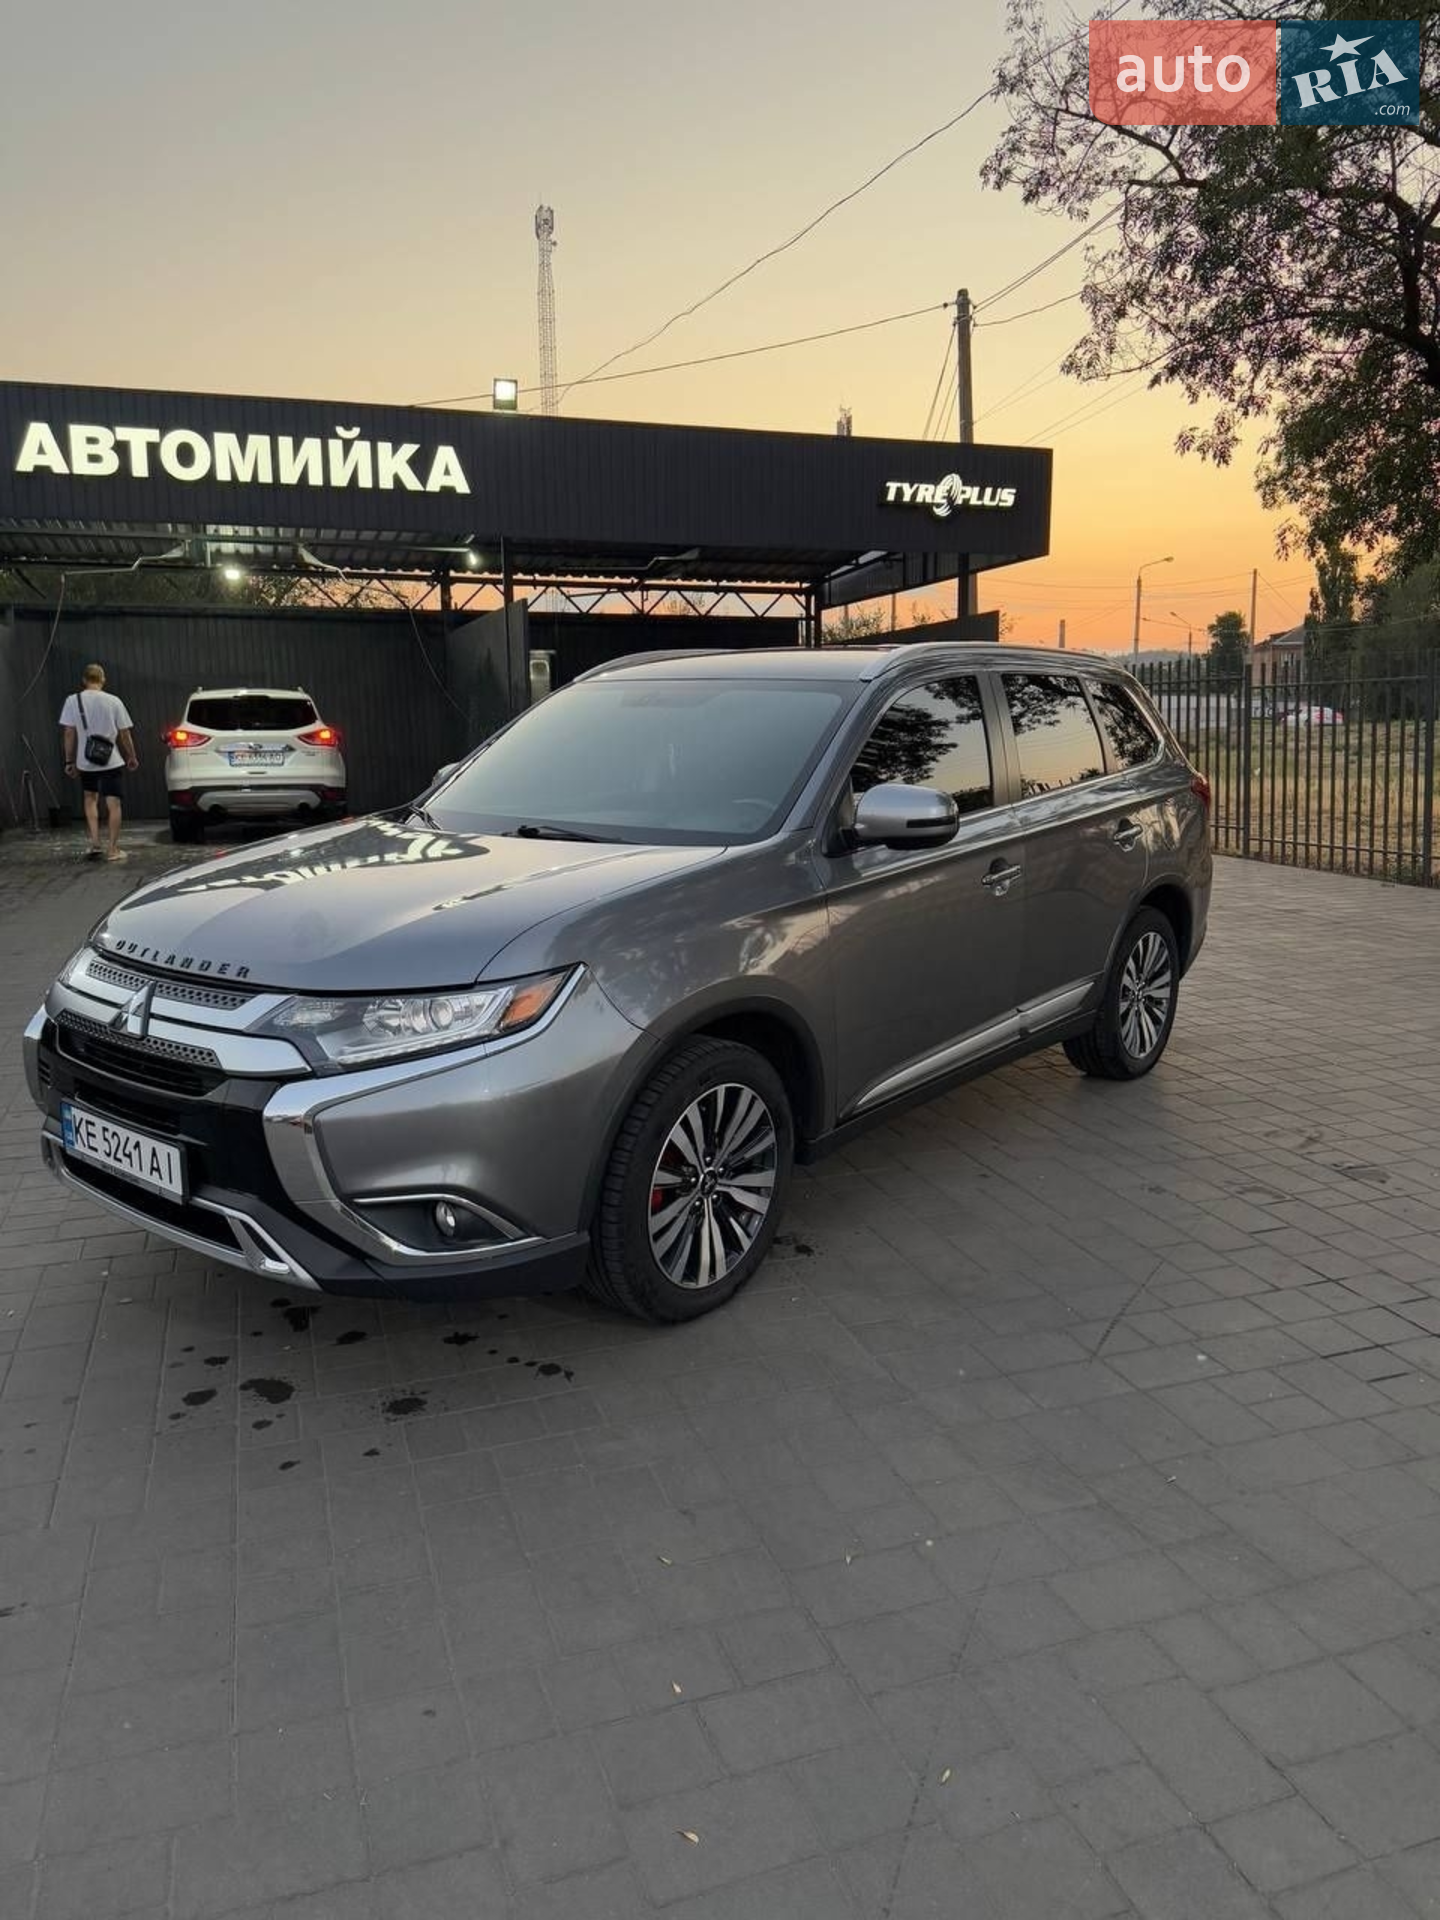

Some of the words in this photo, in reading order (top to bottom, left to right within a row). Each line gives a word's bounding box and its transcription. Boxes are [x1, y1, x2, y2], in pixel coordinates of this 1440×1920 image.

[15, 422, 471, 494] АВТОМИЙКА
[116, 940, 250, 979] OUTLANDER
[72, 1114, 98, 1153] KE
[102, 1126, 143, 1172] 5241
[150, 1146, 173, 1185] AI
